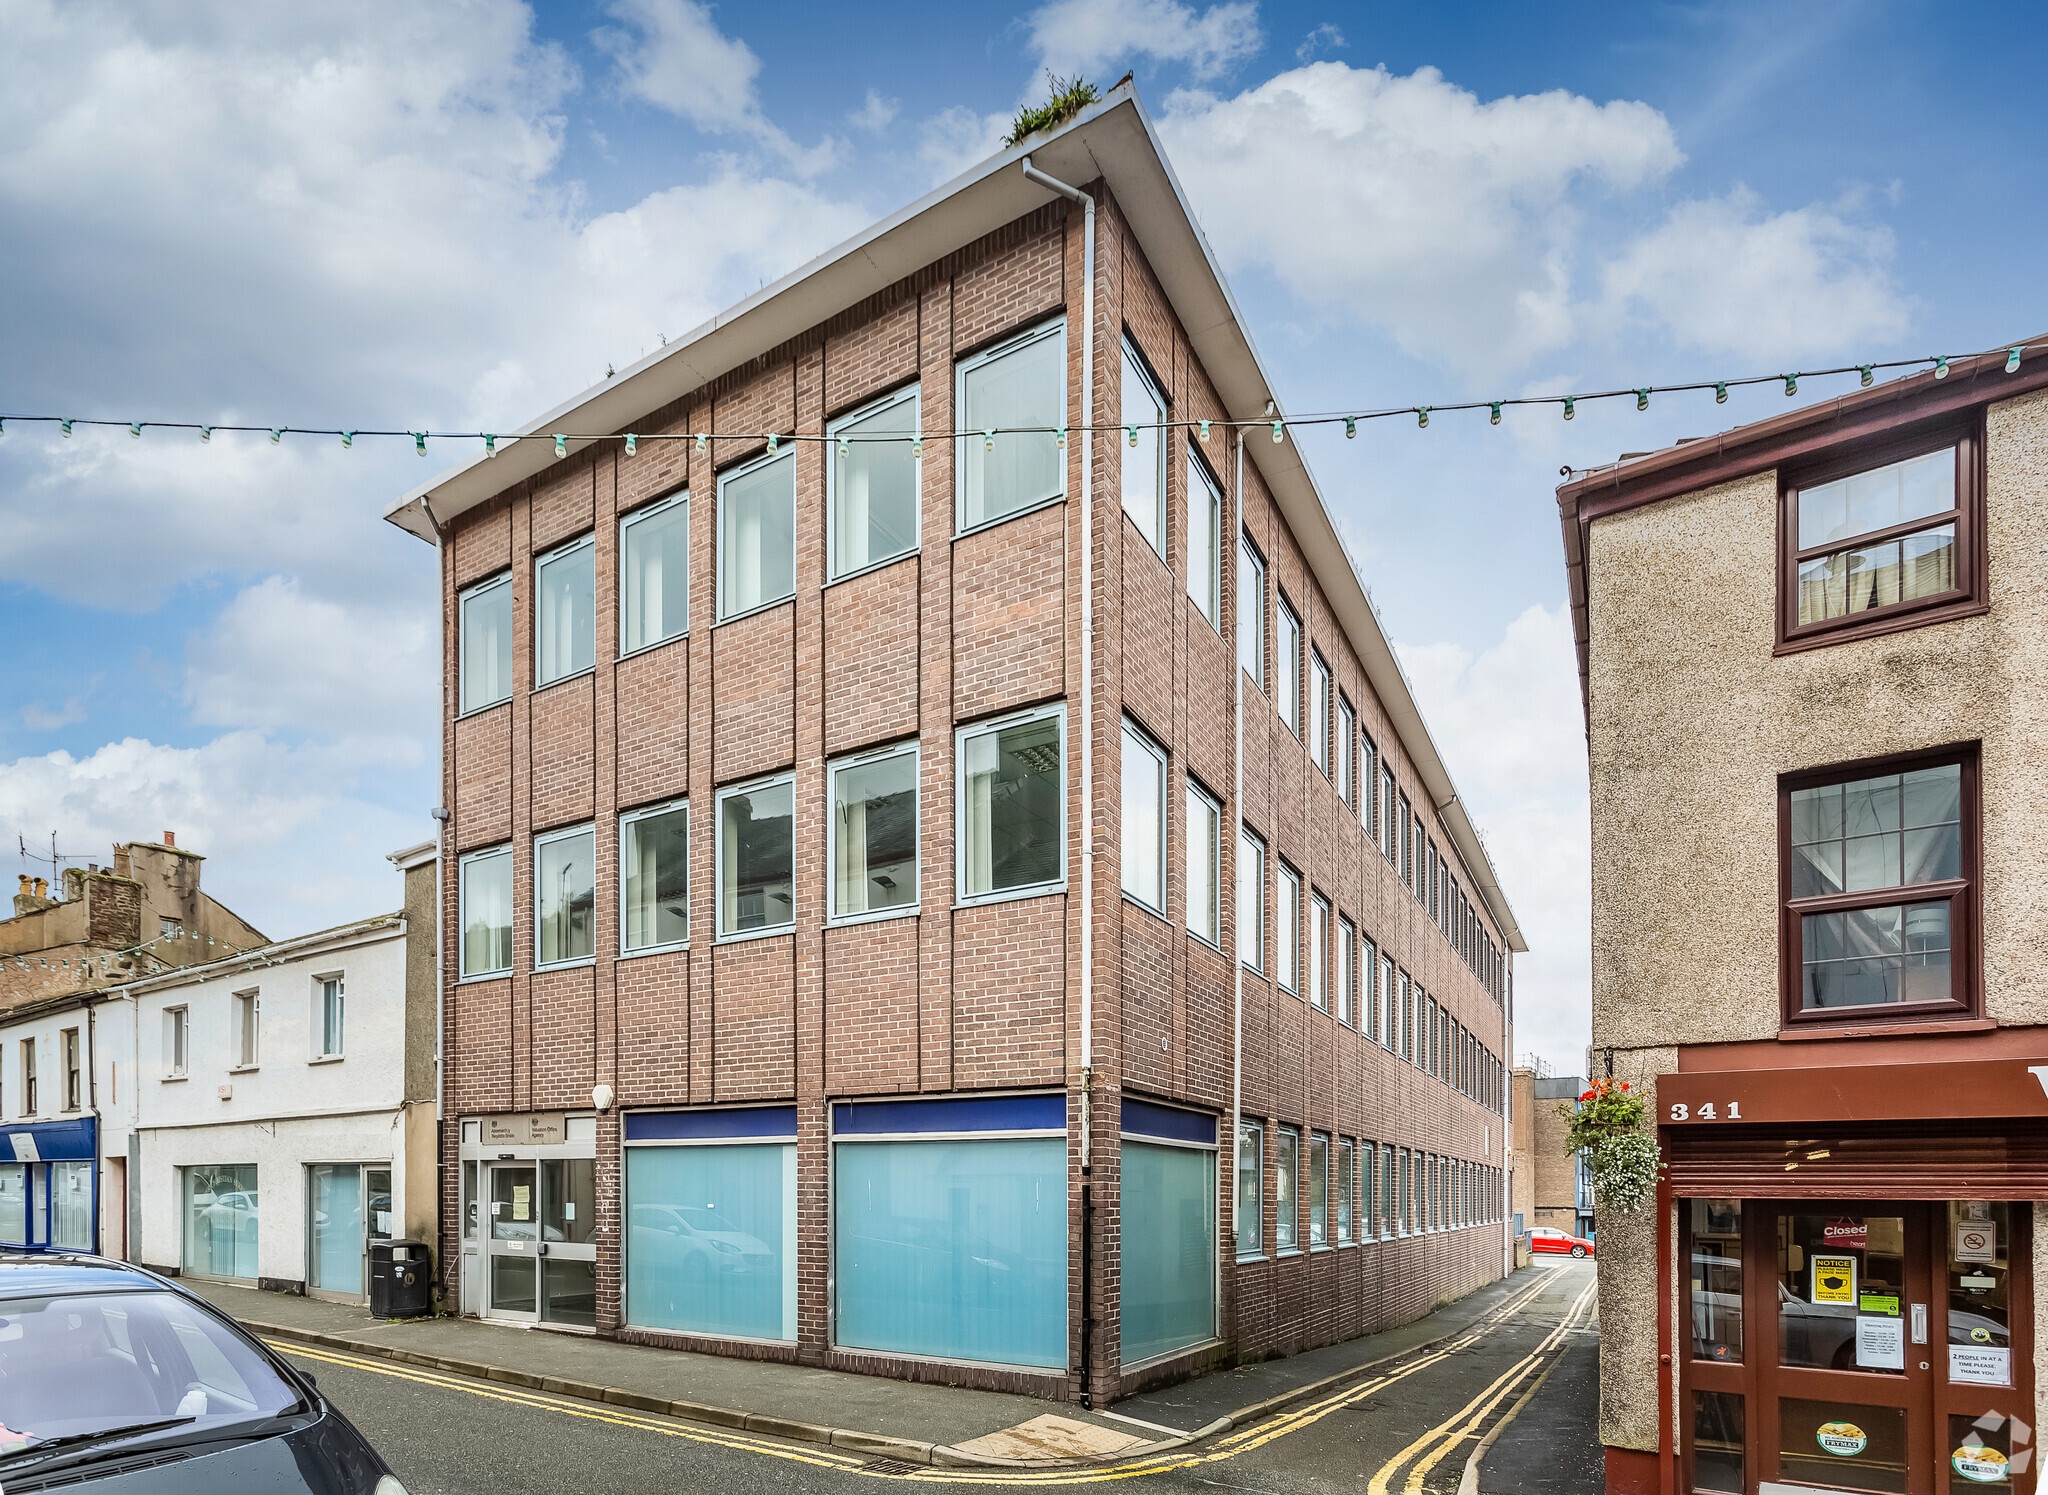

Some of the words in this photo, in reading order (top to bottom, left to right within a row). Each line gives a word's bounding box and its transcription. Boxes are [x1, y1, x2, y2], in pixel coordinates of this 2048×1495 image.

[1670, 1101, 1742, 1121] 341
[1824, 1224, 1867, 1236] Closed
[1826, 1440, 1858, 1448] FRYMAX
[1963, 1464, 1998, 1473] FRYMAX
